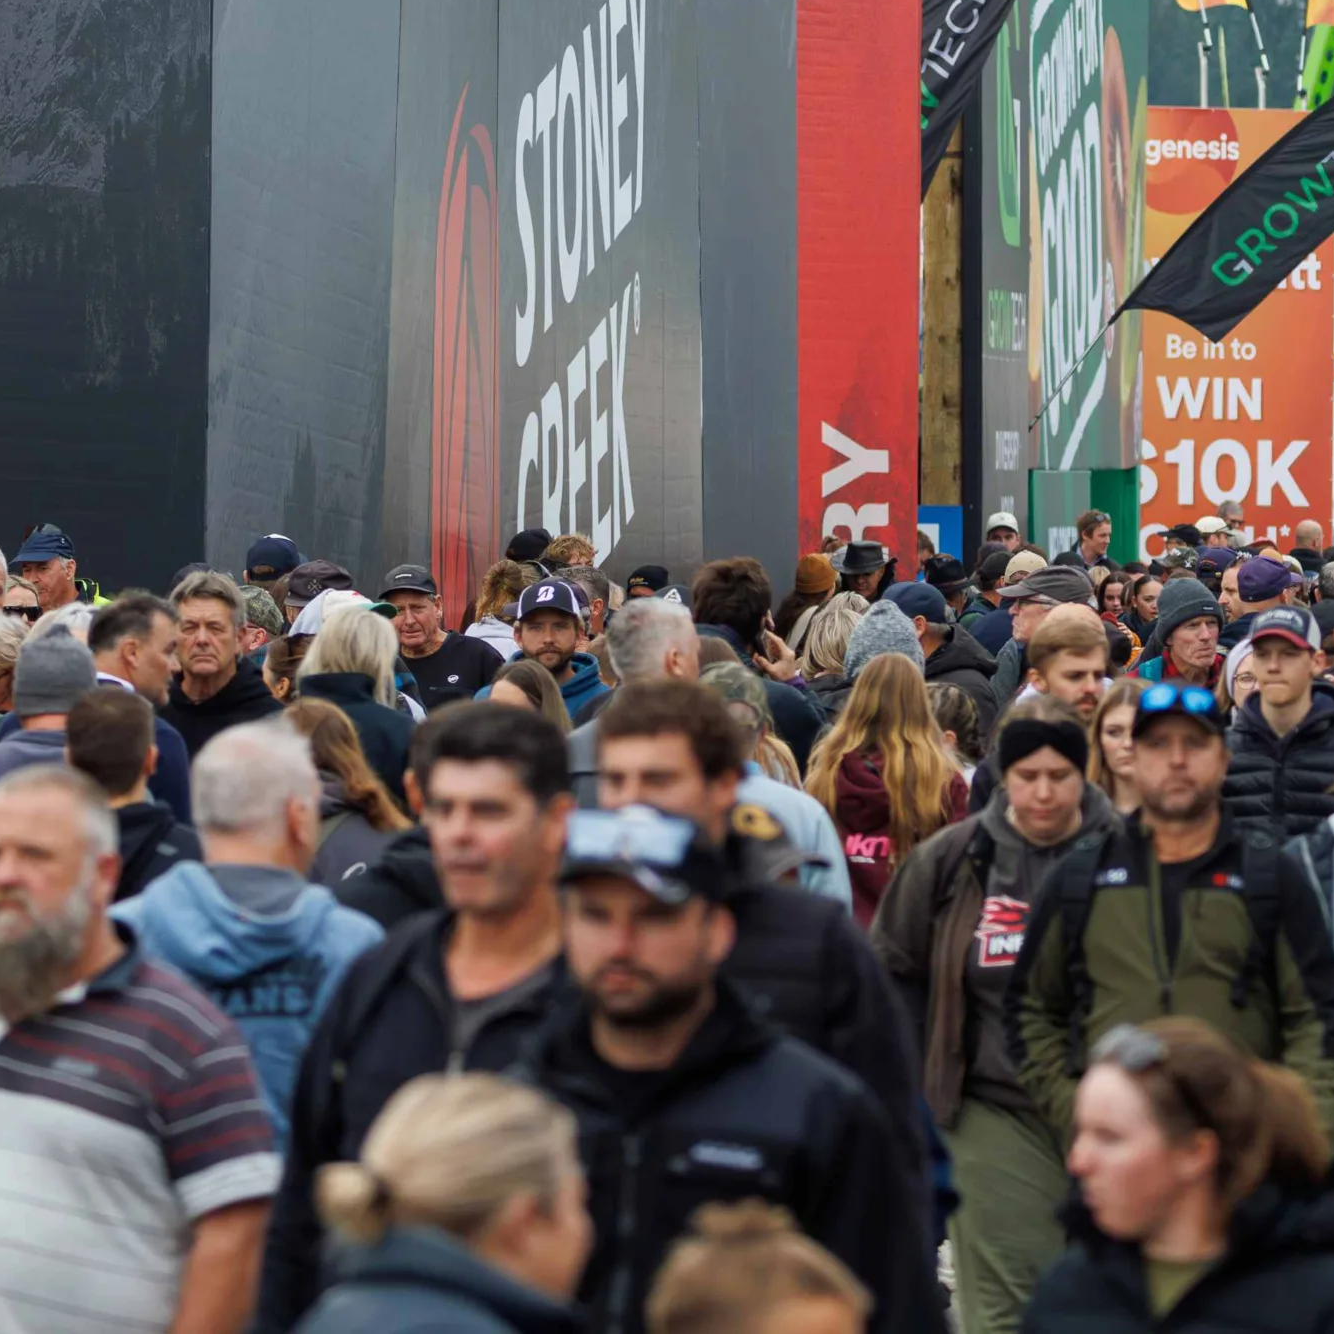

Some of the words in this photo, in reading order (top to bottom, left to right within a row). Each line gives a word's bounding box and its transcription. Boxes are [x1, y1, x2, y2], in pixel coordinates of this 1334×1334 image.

[1037, 2, 1081, 176] GROWN
[1145, 134, 1240, 165] genesis
[1166, 334, 1197, 359] Be
[1203, 336, 1225, 360] in
[1231, 338, 1257, 361] to
[1156, 376, 1262, 421] WIN
